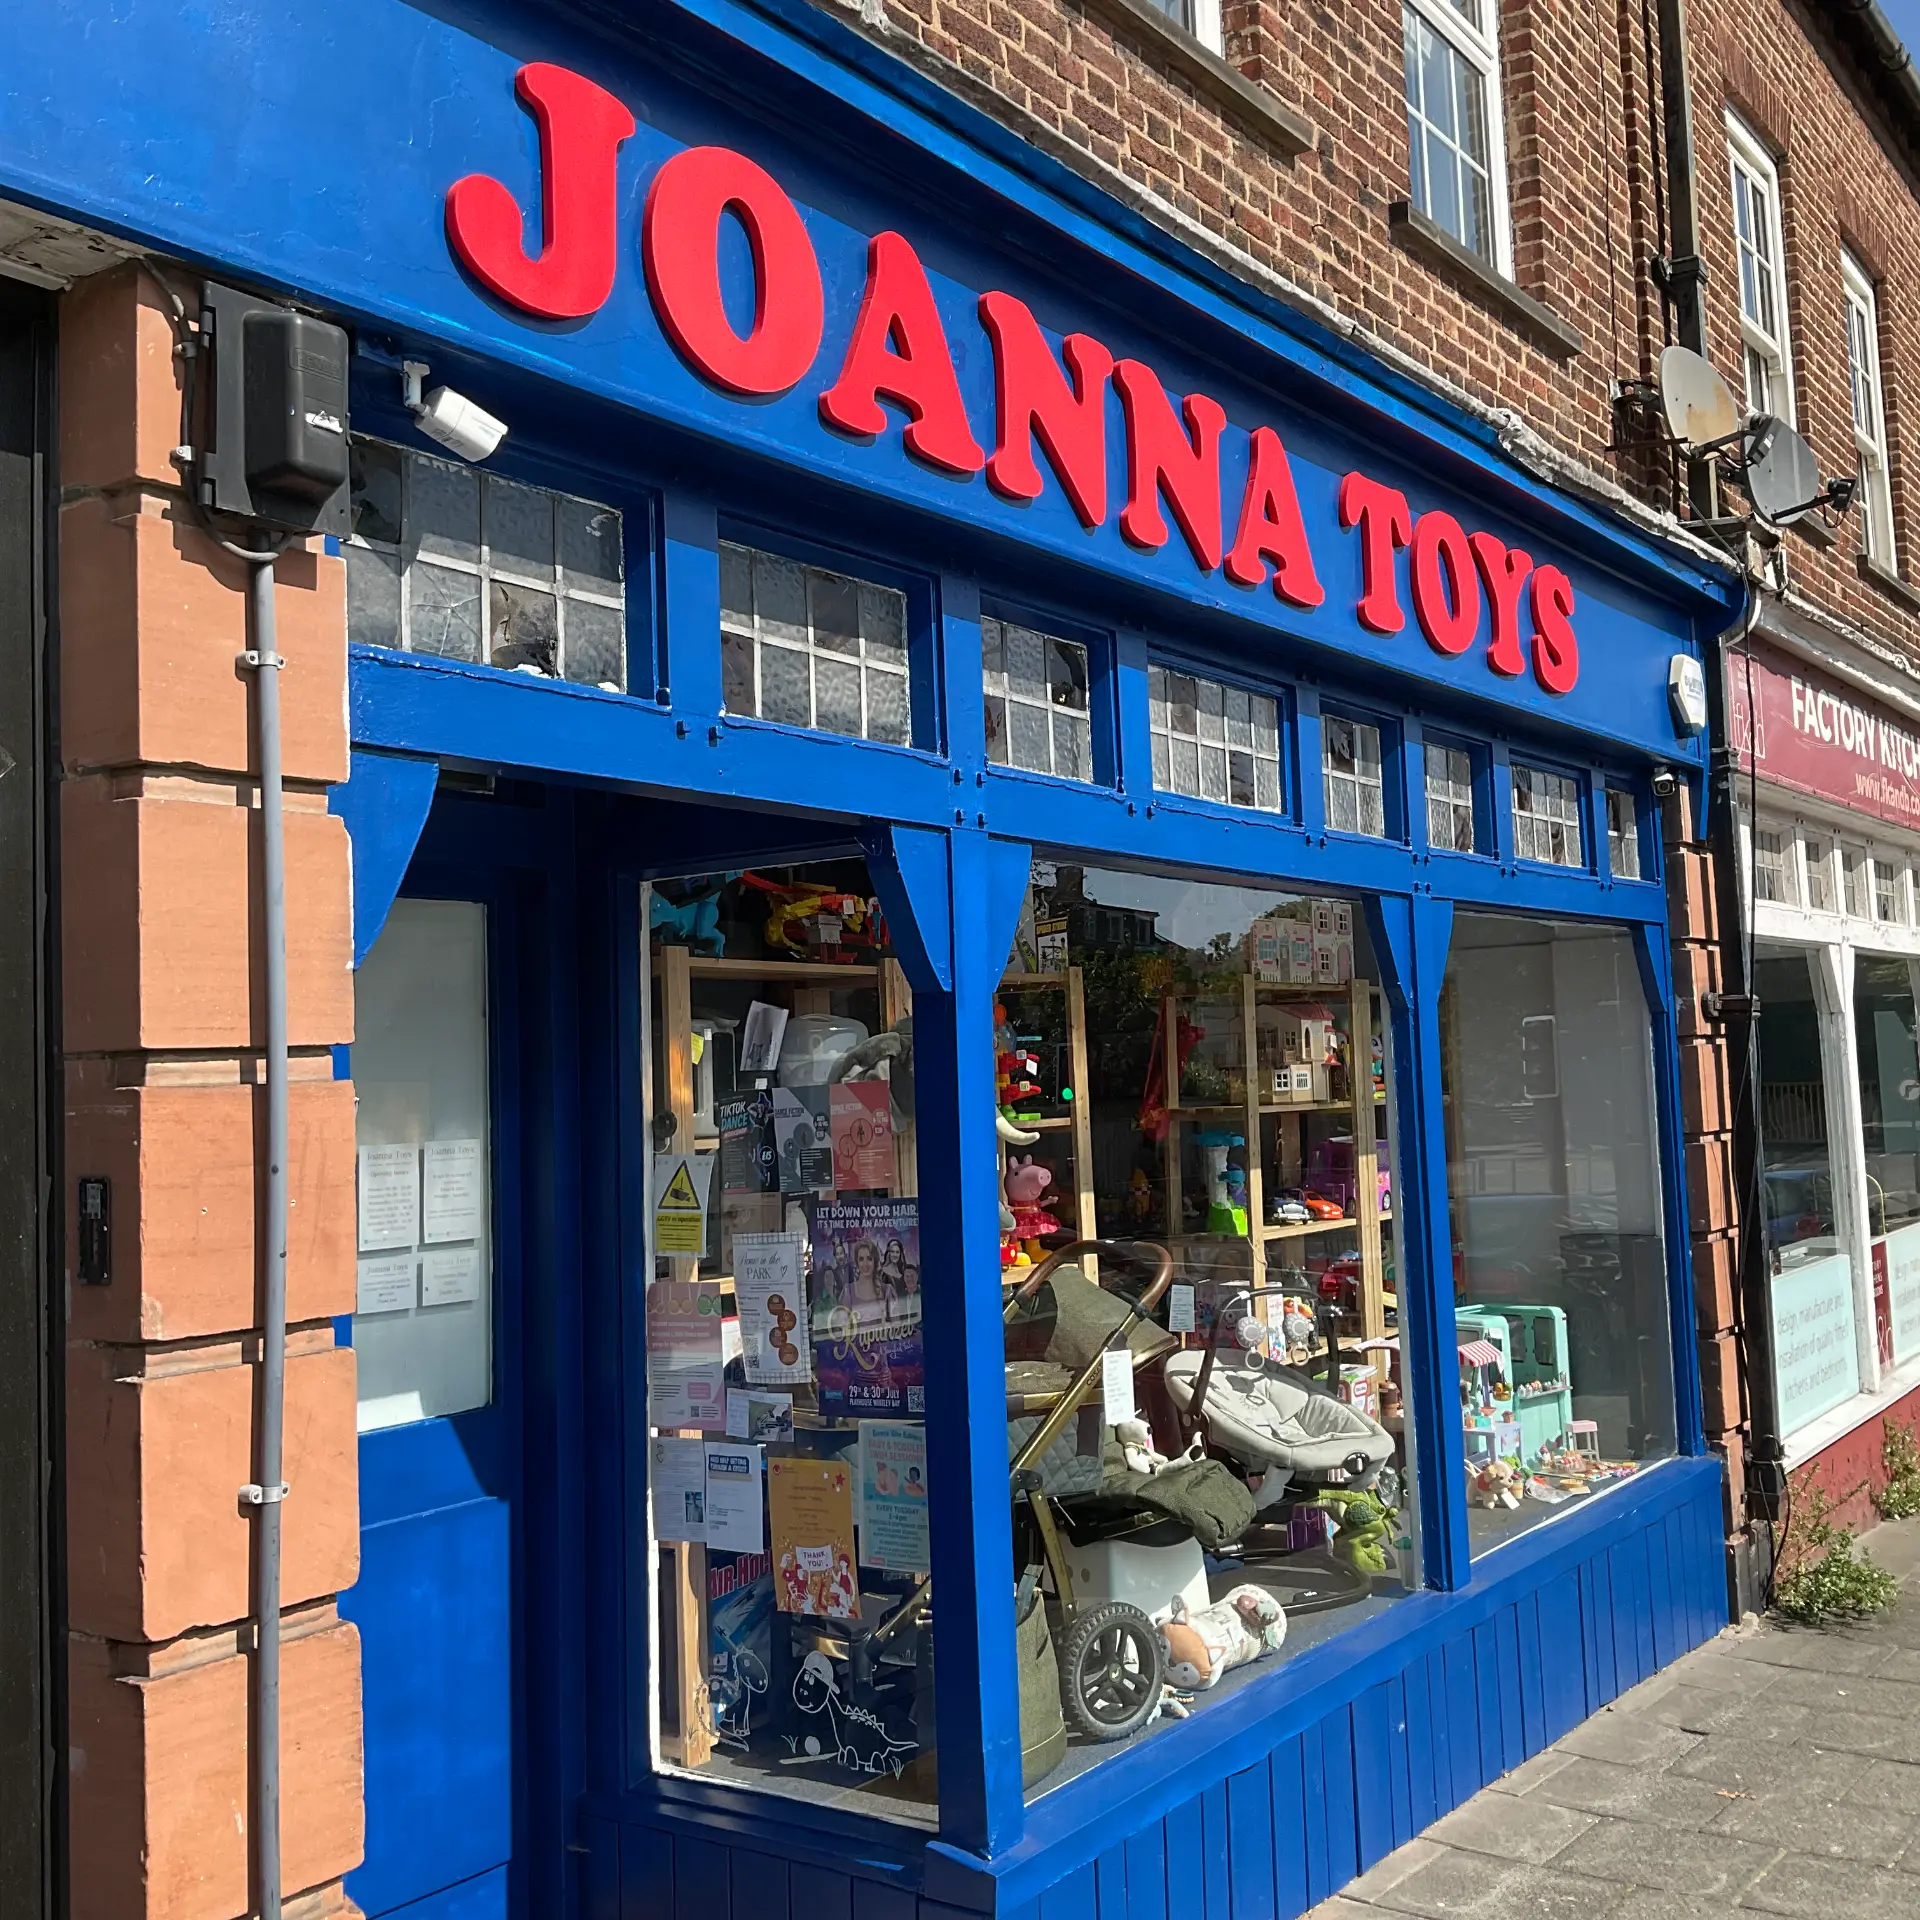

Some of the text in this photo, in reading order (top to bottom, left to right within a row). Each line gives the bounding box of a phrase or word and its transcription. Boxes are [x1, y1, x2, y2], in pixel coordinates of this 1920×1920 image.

[445, 61, 1579, 694] JOANNA TOYS
[1791, 675, 1876, 761] FACTORY
[720, 1101, 746, 1118] TIKTOK
[721, 1112, 748, 1131] DANCE
[762, 1150, 772, 1161] £15
[816, 1207, 829, 1219] LET
[831, 1206, 860, 1218] DOWN
[863, 1205, 890, 1217] YOUR
[817, 1220, 828, 1229] IT'S
[829, 1220, 844, 1229] TIME
[846, 1219, 860, 1228] FOR
[862, 1219, 872, 1228] AN
[746, 1267, 772, 1280] PARK
[827, 1305, 915, 1370] Rapunzel
[864, 1386, 869, 1397] &
[803, 1551, 825, 1559] THANK
